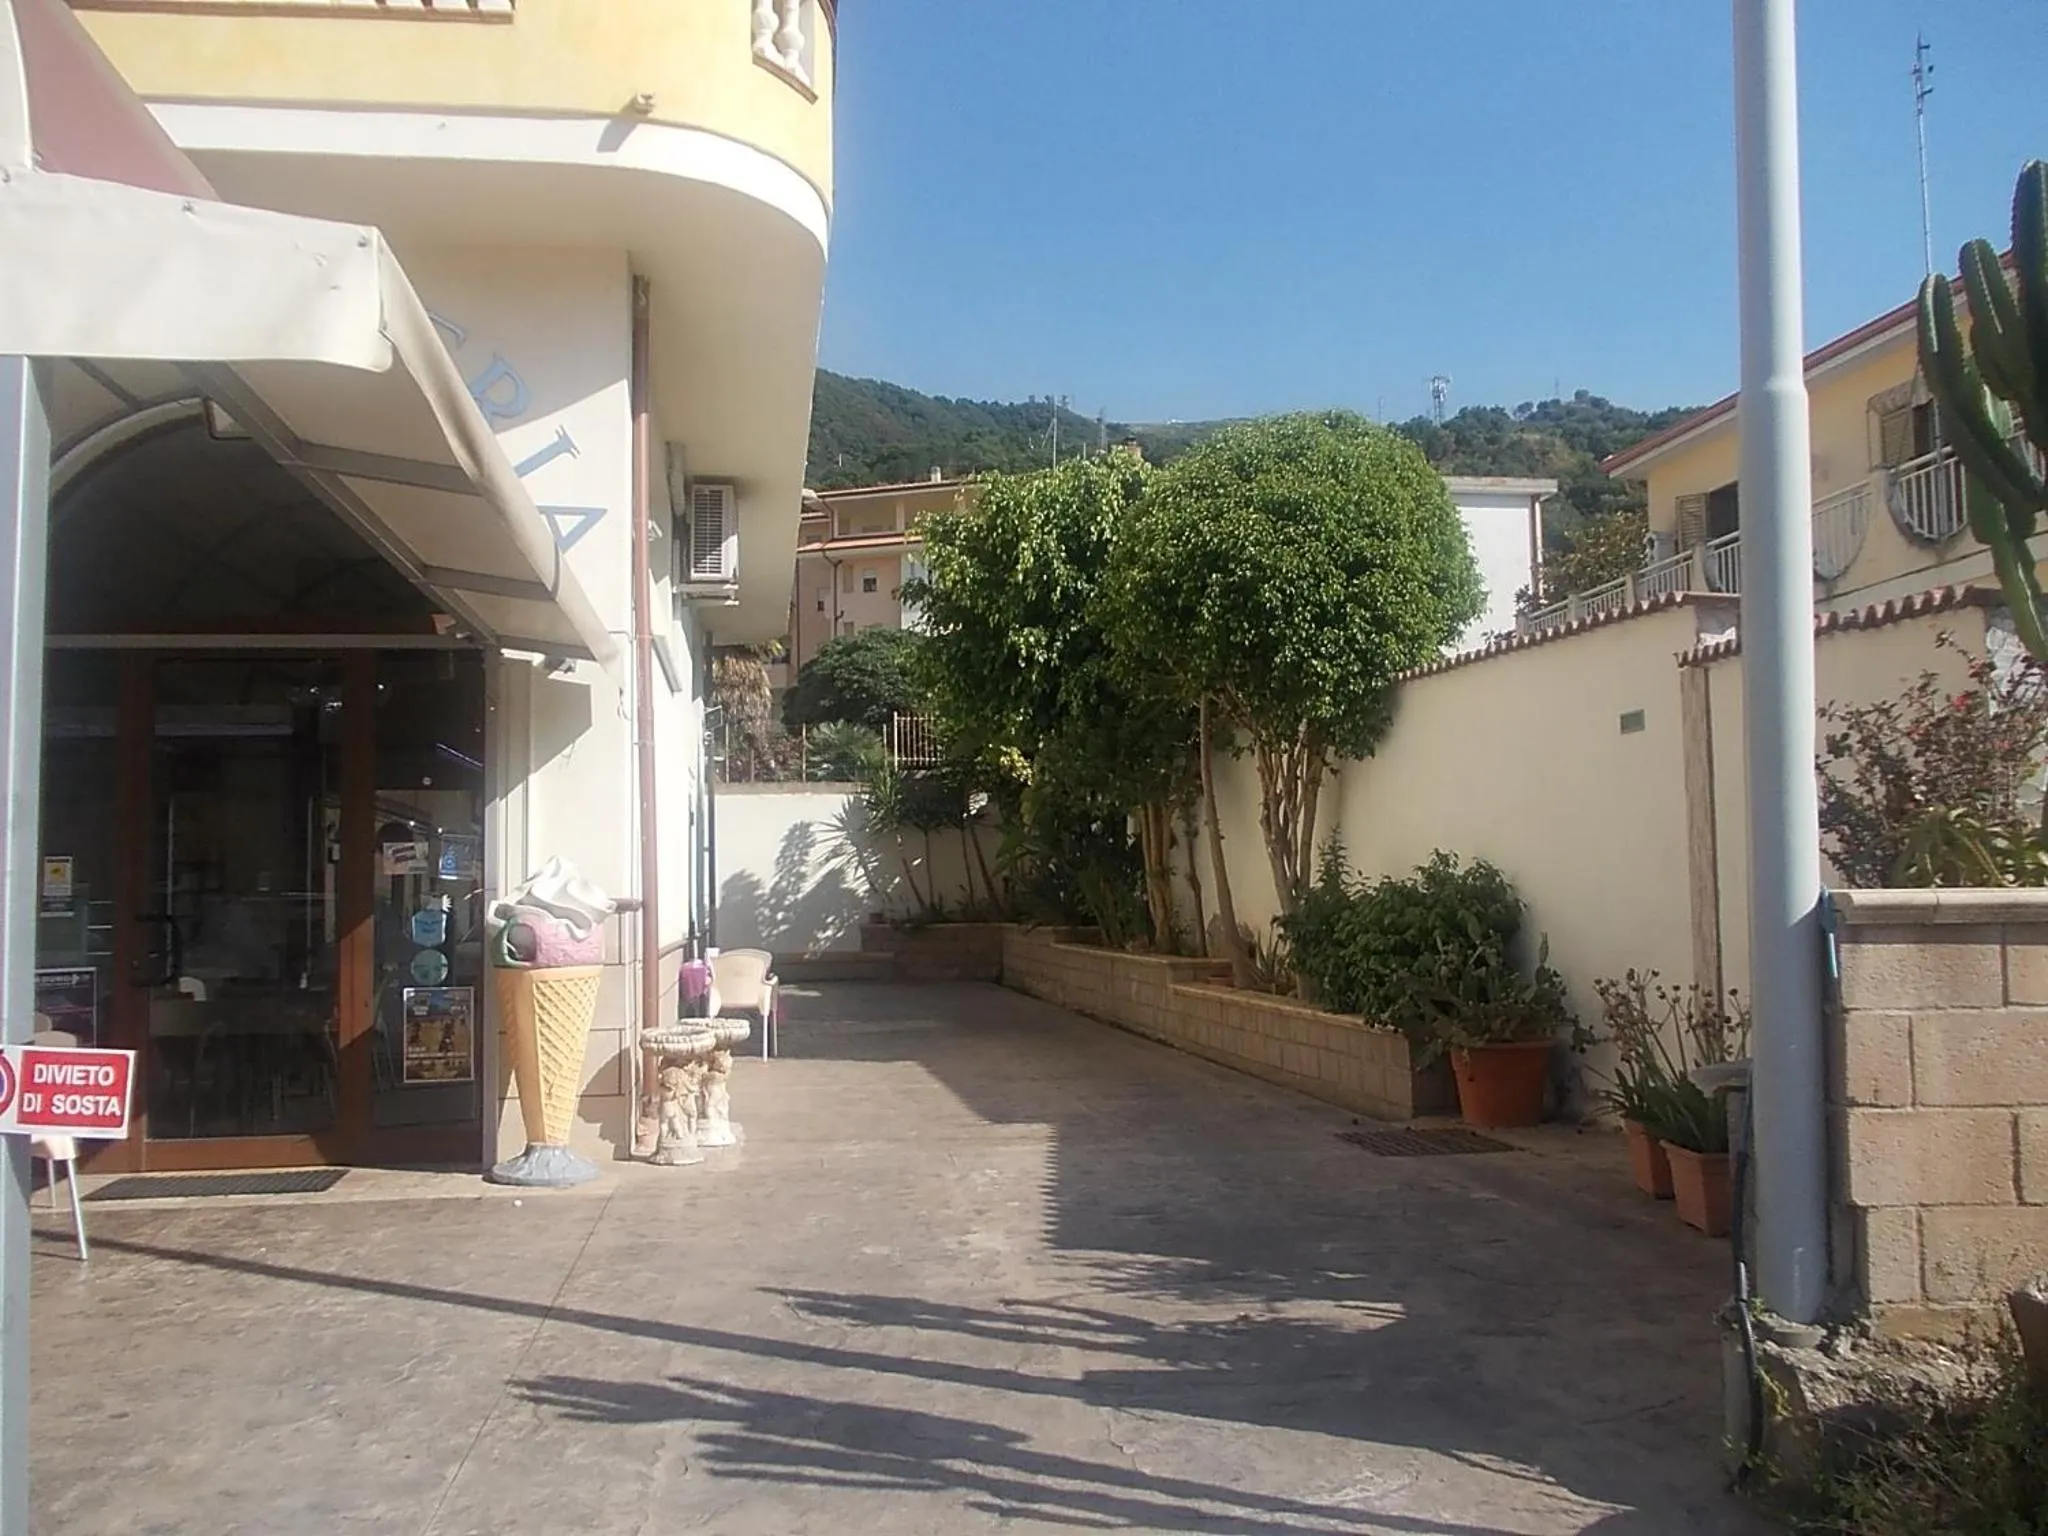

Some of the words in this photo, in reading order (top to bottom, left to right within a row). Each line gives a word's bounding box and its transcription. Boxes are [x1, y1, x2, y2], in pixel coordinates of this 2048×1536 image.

[427, 309, 608, 555] RIA
[33, 1063, 115, 1087] DIVIETO
[22, 1092, 42, 1113] DI
[51, 1094, 122, 1116] SOSTA
